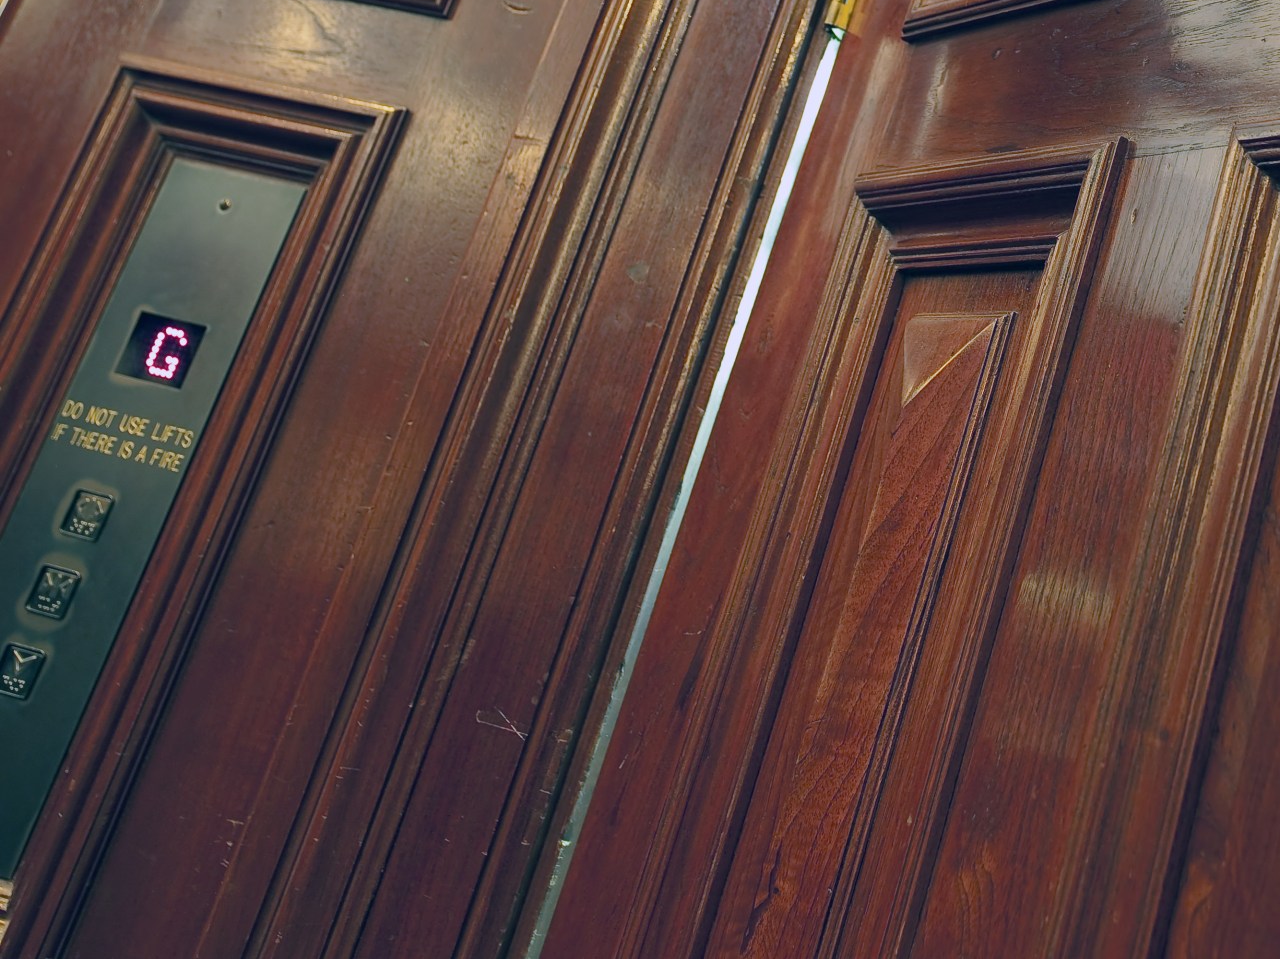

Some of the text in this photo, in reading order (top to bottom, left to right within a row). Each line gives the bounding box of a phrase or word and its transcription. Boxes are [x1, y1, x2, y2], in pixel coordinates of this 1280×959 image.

[145, 326, 188, 379] G
[50, 422, 185, 473] IF THERE IS A FIRE
[61, 399, 194, 449] DO NOT USE LIFTS
